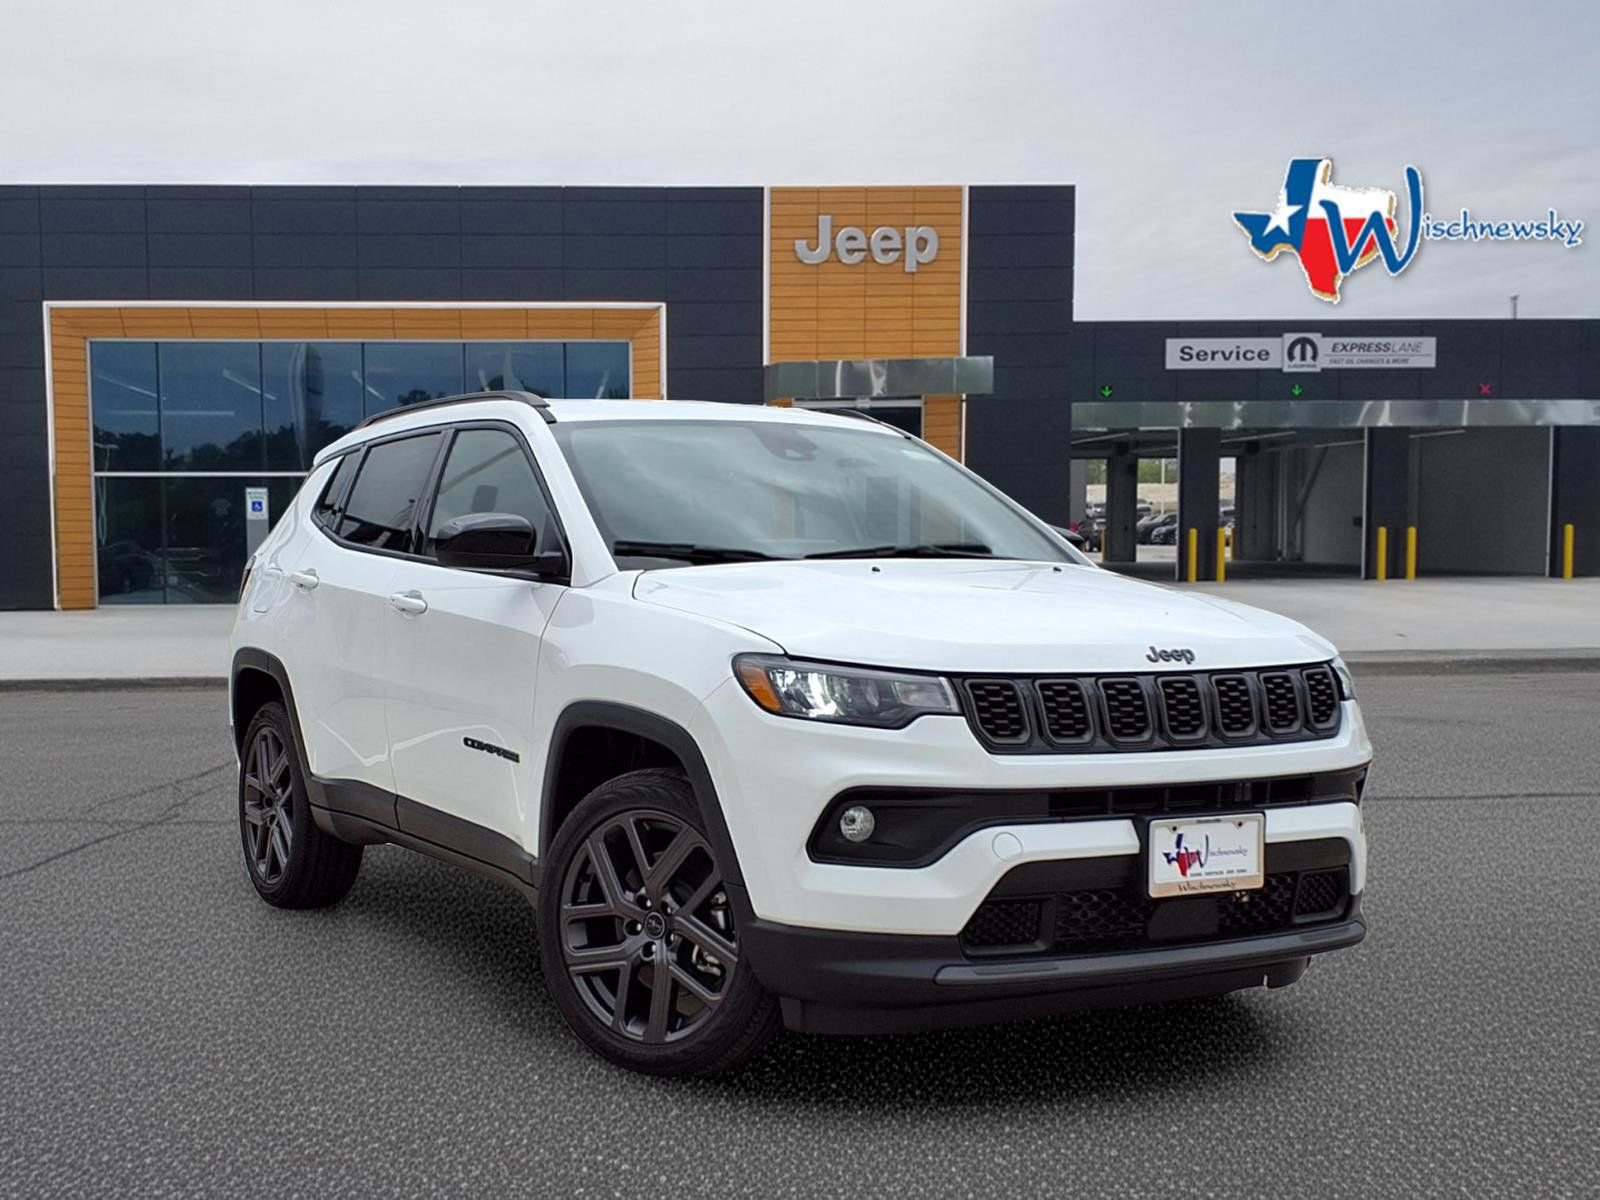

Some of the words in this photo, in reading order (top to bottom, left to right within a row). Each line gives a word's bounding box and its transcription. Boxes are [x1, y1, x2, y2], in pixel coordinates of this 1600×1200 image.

[795, 215, 939, 272] Jeep
[1179, 345, 1271, 362] Service
[1145, 646, 1196, 665] Jeep
